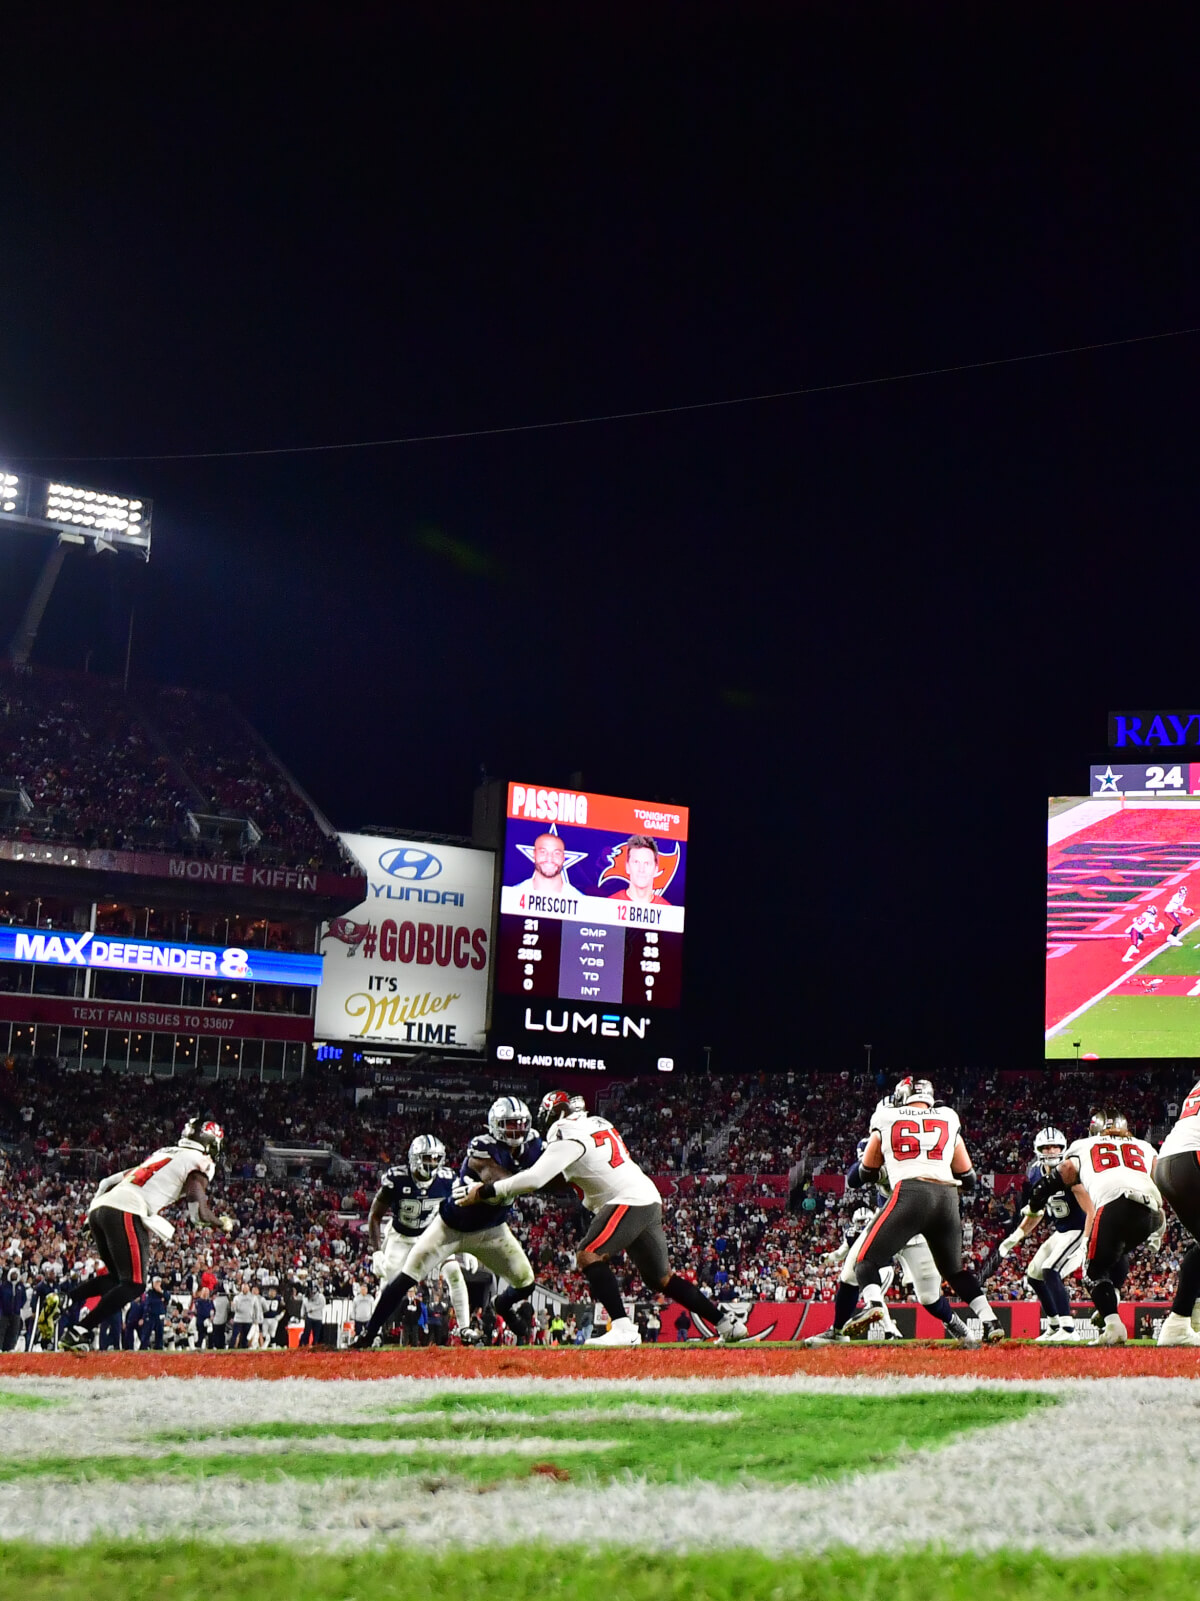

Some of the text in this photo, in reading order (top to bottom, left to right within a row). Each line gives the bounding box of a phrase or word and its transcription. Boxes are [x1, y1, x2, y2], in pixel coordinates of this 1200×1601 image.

[1145, 766, 1183, 789] 24
[512, 786, 588, 824] PASSING
[634, 809, 680, 824] TONIGHT'S
[644, 820, 669, 831] GAME
[169, 859, 317, 891] MONTE KIFFIN
[370, 883, 465, 907] YUNDAI
[519, 894, 579, 915] 4 PRESCOTT
[617, 905, 662, 924] 12 BRADY
[524, 919, 539, 932] 21
[580, 927, 607, 937] CMP
[363, 918, 488, 971] #GOBUCS
[522, 933, 539, 946] 27
[580, 943, 604, 952] ATT
[15, 931, 249, 978] MAX DEFENDER 8
[579, 957, 604, 967] YDS
[368, 975, 398, 992] IT'S
[523, 978, 653, 1002] 0 INT 1
[583, 971, 599, 981] TD
[644, 975, 654, 987] 0
[72, 1007, 234, 1030] TEXT FAN ISSUES TO 33607
[345, 992, 461, 1036] Miller
[525, 1008, 646, 1039] LUMEN
[404, 1021, 457, 1044] TIME
[517, 1054, 597, 1069] 1st AND 10 AT THE
[891, 1119, 949, 1161] 67
[1090, 1143, 1148, 1173] 66
